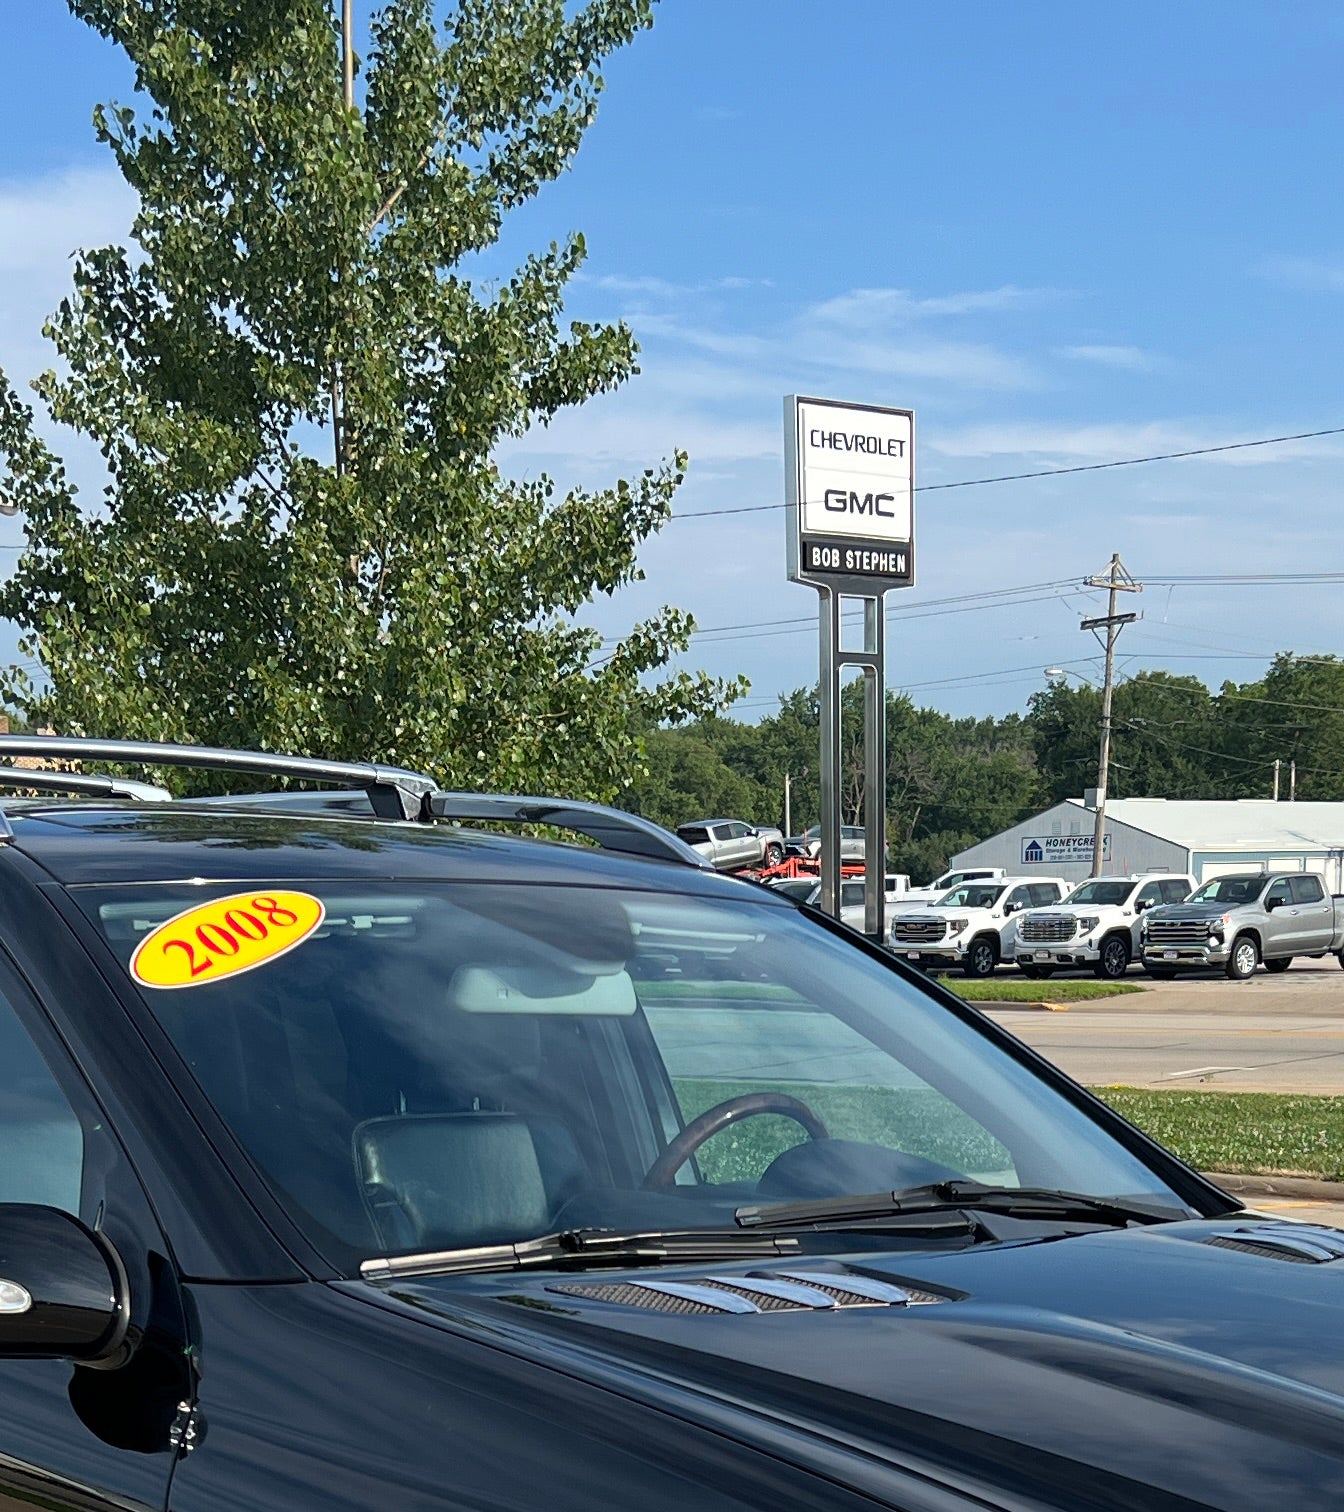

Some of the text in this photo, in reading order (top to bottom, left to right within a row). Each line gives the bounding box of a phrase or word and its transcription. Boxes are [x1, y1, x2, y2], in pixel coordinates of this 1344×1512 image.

[810, 429, 906, 458] CHEVROLET
[824, 489, 895, 518] GMC
[812, 546, 906, 573] BOB STEPHEN
[1045, 836, 1108, 848] HONEYCREK
[163, 897, 298, 977] 2008
